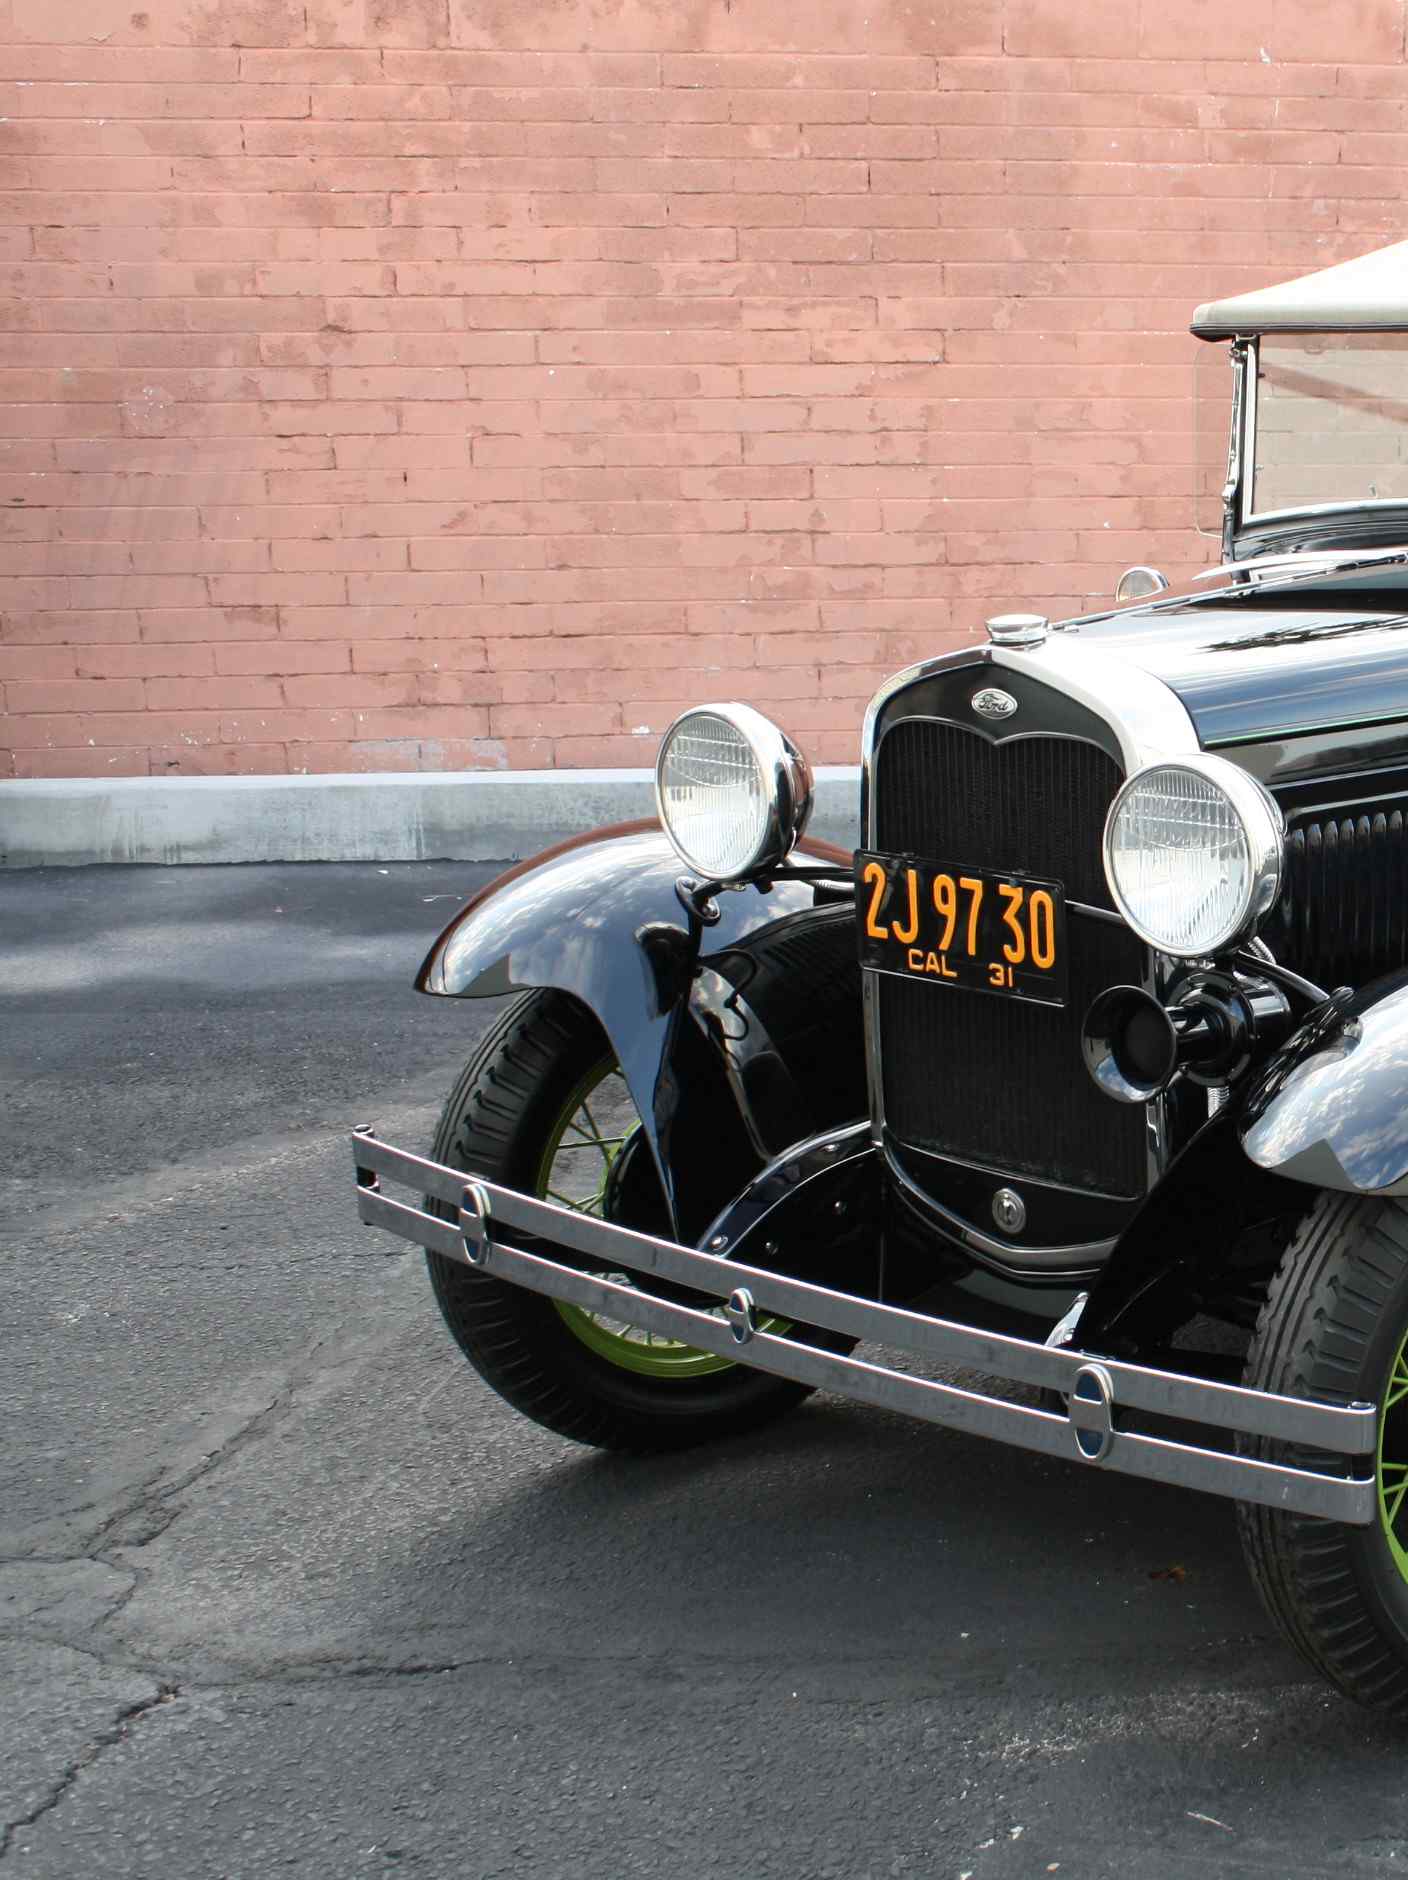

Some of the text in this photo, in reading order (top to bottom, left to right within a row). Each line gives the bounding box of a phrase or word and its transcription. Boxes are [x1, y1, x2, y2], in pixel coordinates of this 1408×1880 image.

[976, 693, 1010, 712] Ford
[864, 862, 1055, 969] 2J 97 30
[908, 949, 1013, 988] CAL 31
